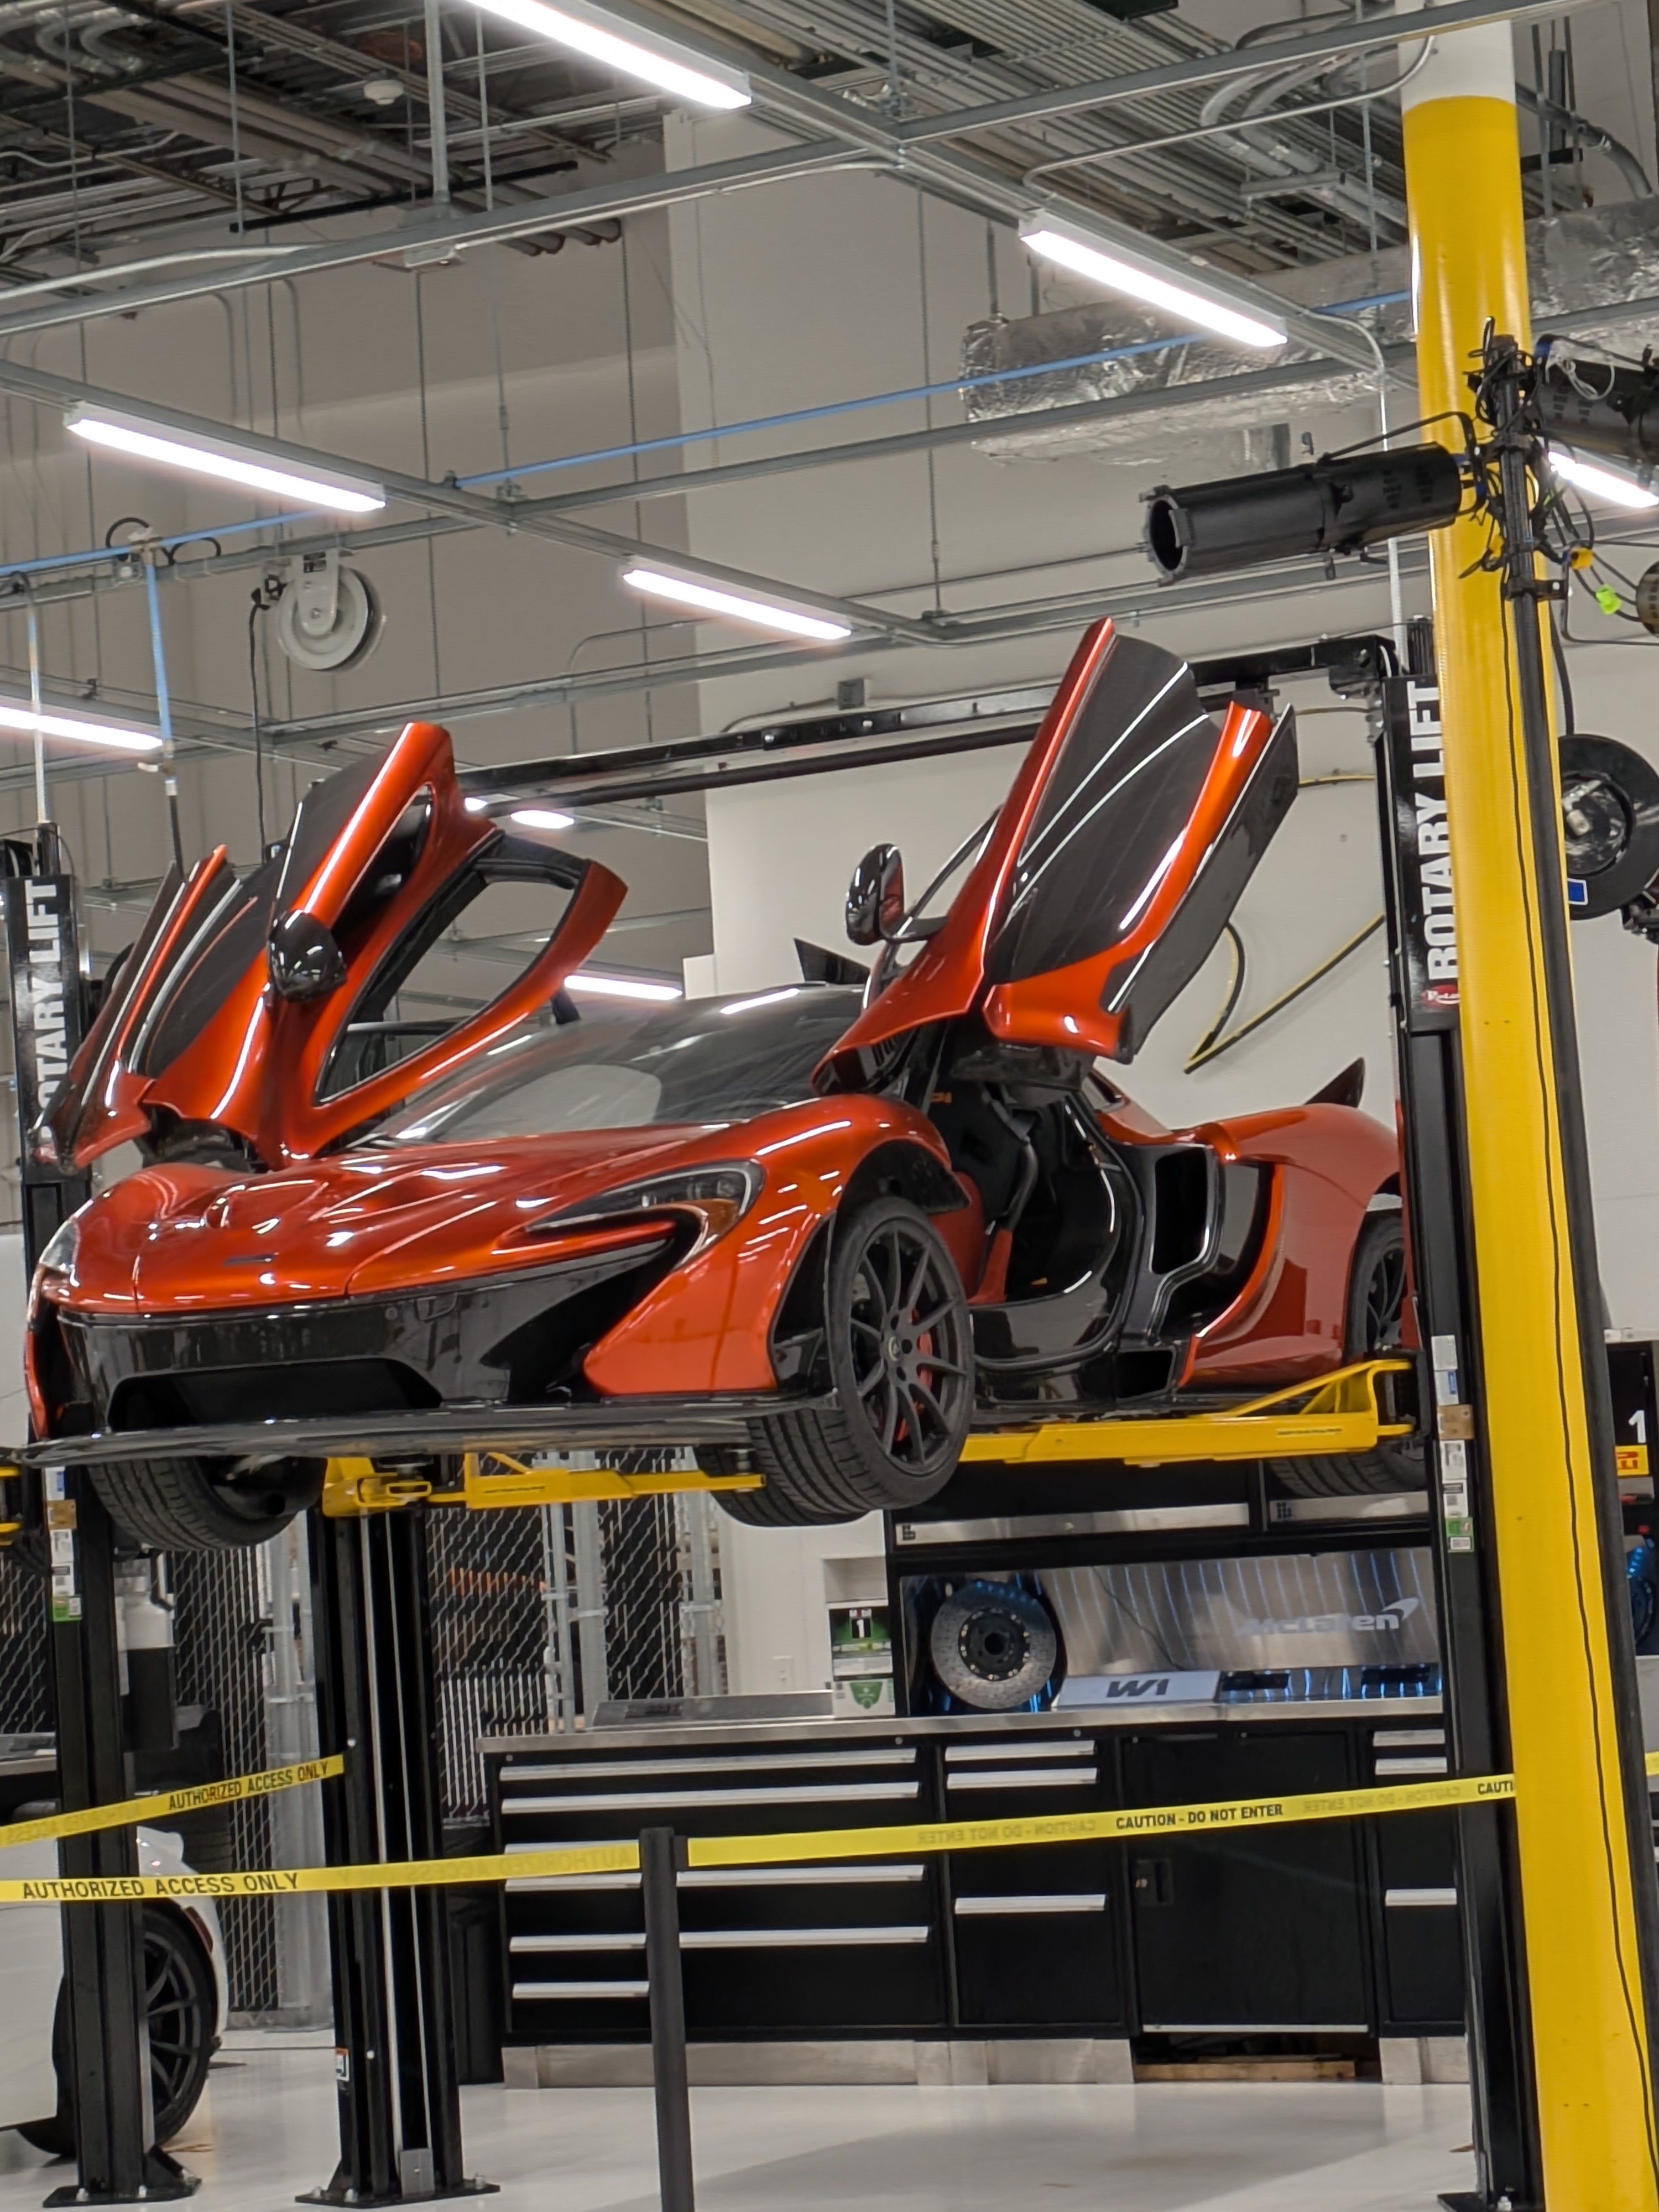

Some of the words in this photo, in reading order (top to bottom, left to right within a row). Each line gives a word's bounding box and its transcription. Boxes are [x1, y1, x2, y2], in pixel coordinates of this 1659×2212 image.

[1406, 680, 1445, 779] LIFT
[1415, 792, 1458, 980] ROTARY
[24, 879, 61, 964] LIFT
[31, 975, 67, 1138] OTARY
[1629, 1410, 1646, 1443] 1
[856, 1619, 865, 1639] 1
[1106, 1678, 1170, 1698] W1
[169, 1781, 242, 1810] AUTHORIZED
[247, 1769, 293, 1793] ACCESS
[297, 1761, 328, 1781] ONLY
[1115, 1813, 1176, 1829] CAUTION
[1187, 1811, 1206, 1824] DO
[1210, 1808, 1237, 1822] NOT
[1240, 1803, 1284, 1819] ENTER
[23, 1879, 145, 1900] AUTHORIZED
[155, 1876, 236, 1896] ACCESS
[243, 1872, 299, 1891] ONLY
